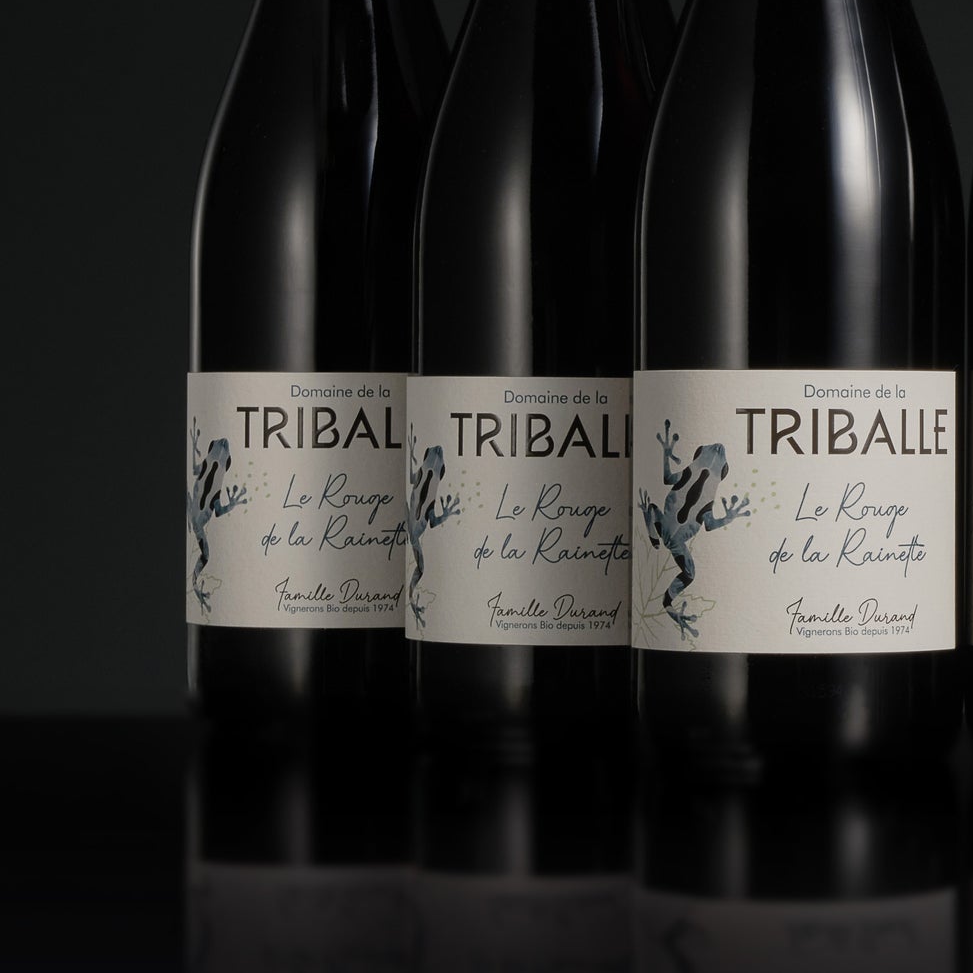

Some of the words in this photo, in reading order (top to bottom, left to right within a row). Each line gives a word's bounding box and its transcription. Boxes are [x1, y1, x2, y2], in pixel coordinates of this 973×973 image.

[291, 384, 353, 398] Domaine
[357, 384, 374, 398] de
[379, 384, 390, 398] la
[504, 390, 568, 404] Domaine
[573, 390, 590, 404] de
[595, 390, 608, 404] la
[804, 384, 871, 399] Domaine
[875, 384, 892, 399] de
[895, 384, 906, 399] la
[736, 408, 948, 455] TRIBALLE
[283, 474, 312, 509] Le
[319, 473, 394, 524] Rouge
[495, 484, 525, 520] Le
[532, 483, 611, 538] Rouge
[795, 483, 828, 522] Le
[835, 482, 909, 538] Rouge
[261, 525, 282, 555] de
[288, 523, 313, 546] la
[473, 535, 495, 570] de
[500, 535, 526, 559] la
[532, 527, 632, 576] Rainette
[769, 538, 793, 574] de
[801, 535, 829, 562] la
[836, 528, 927, 577] Rainette
[274, 577, 335, 611] Famille
[339, 578, 404, 607] Durand
[283, 604, 323, 615] Vignerons
[326, 604, 340, 612] Bio
[342, 604, 370, 614] depuis
[373, 604, 394, 612] 1974
[487, 592, 548, 627] Famille
[553, 594, 622, 624] Durand
[495, 620, 538, 631] Vignerons
[540, 621, 554, 629] Bio
[556, 621, 585, 631] depuis
[589, 621, 611, 629] 1974
[786, 597, 853, 635] Famille
[858, 598, 918, 629] Durand
[796, 627, 842, 638] Vignerons
[844, 627, 859, 636] Bio
[861, 626, 888, 637] depuis
[891, 626, 910, 635] 1974
